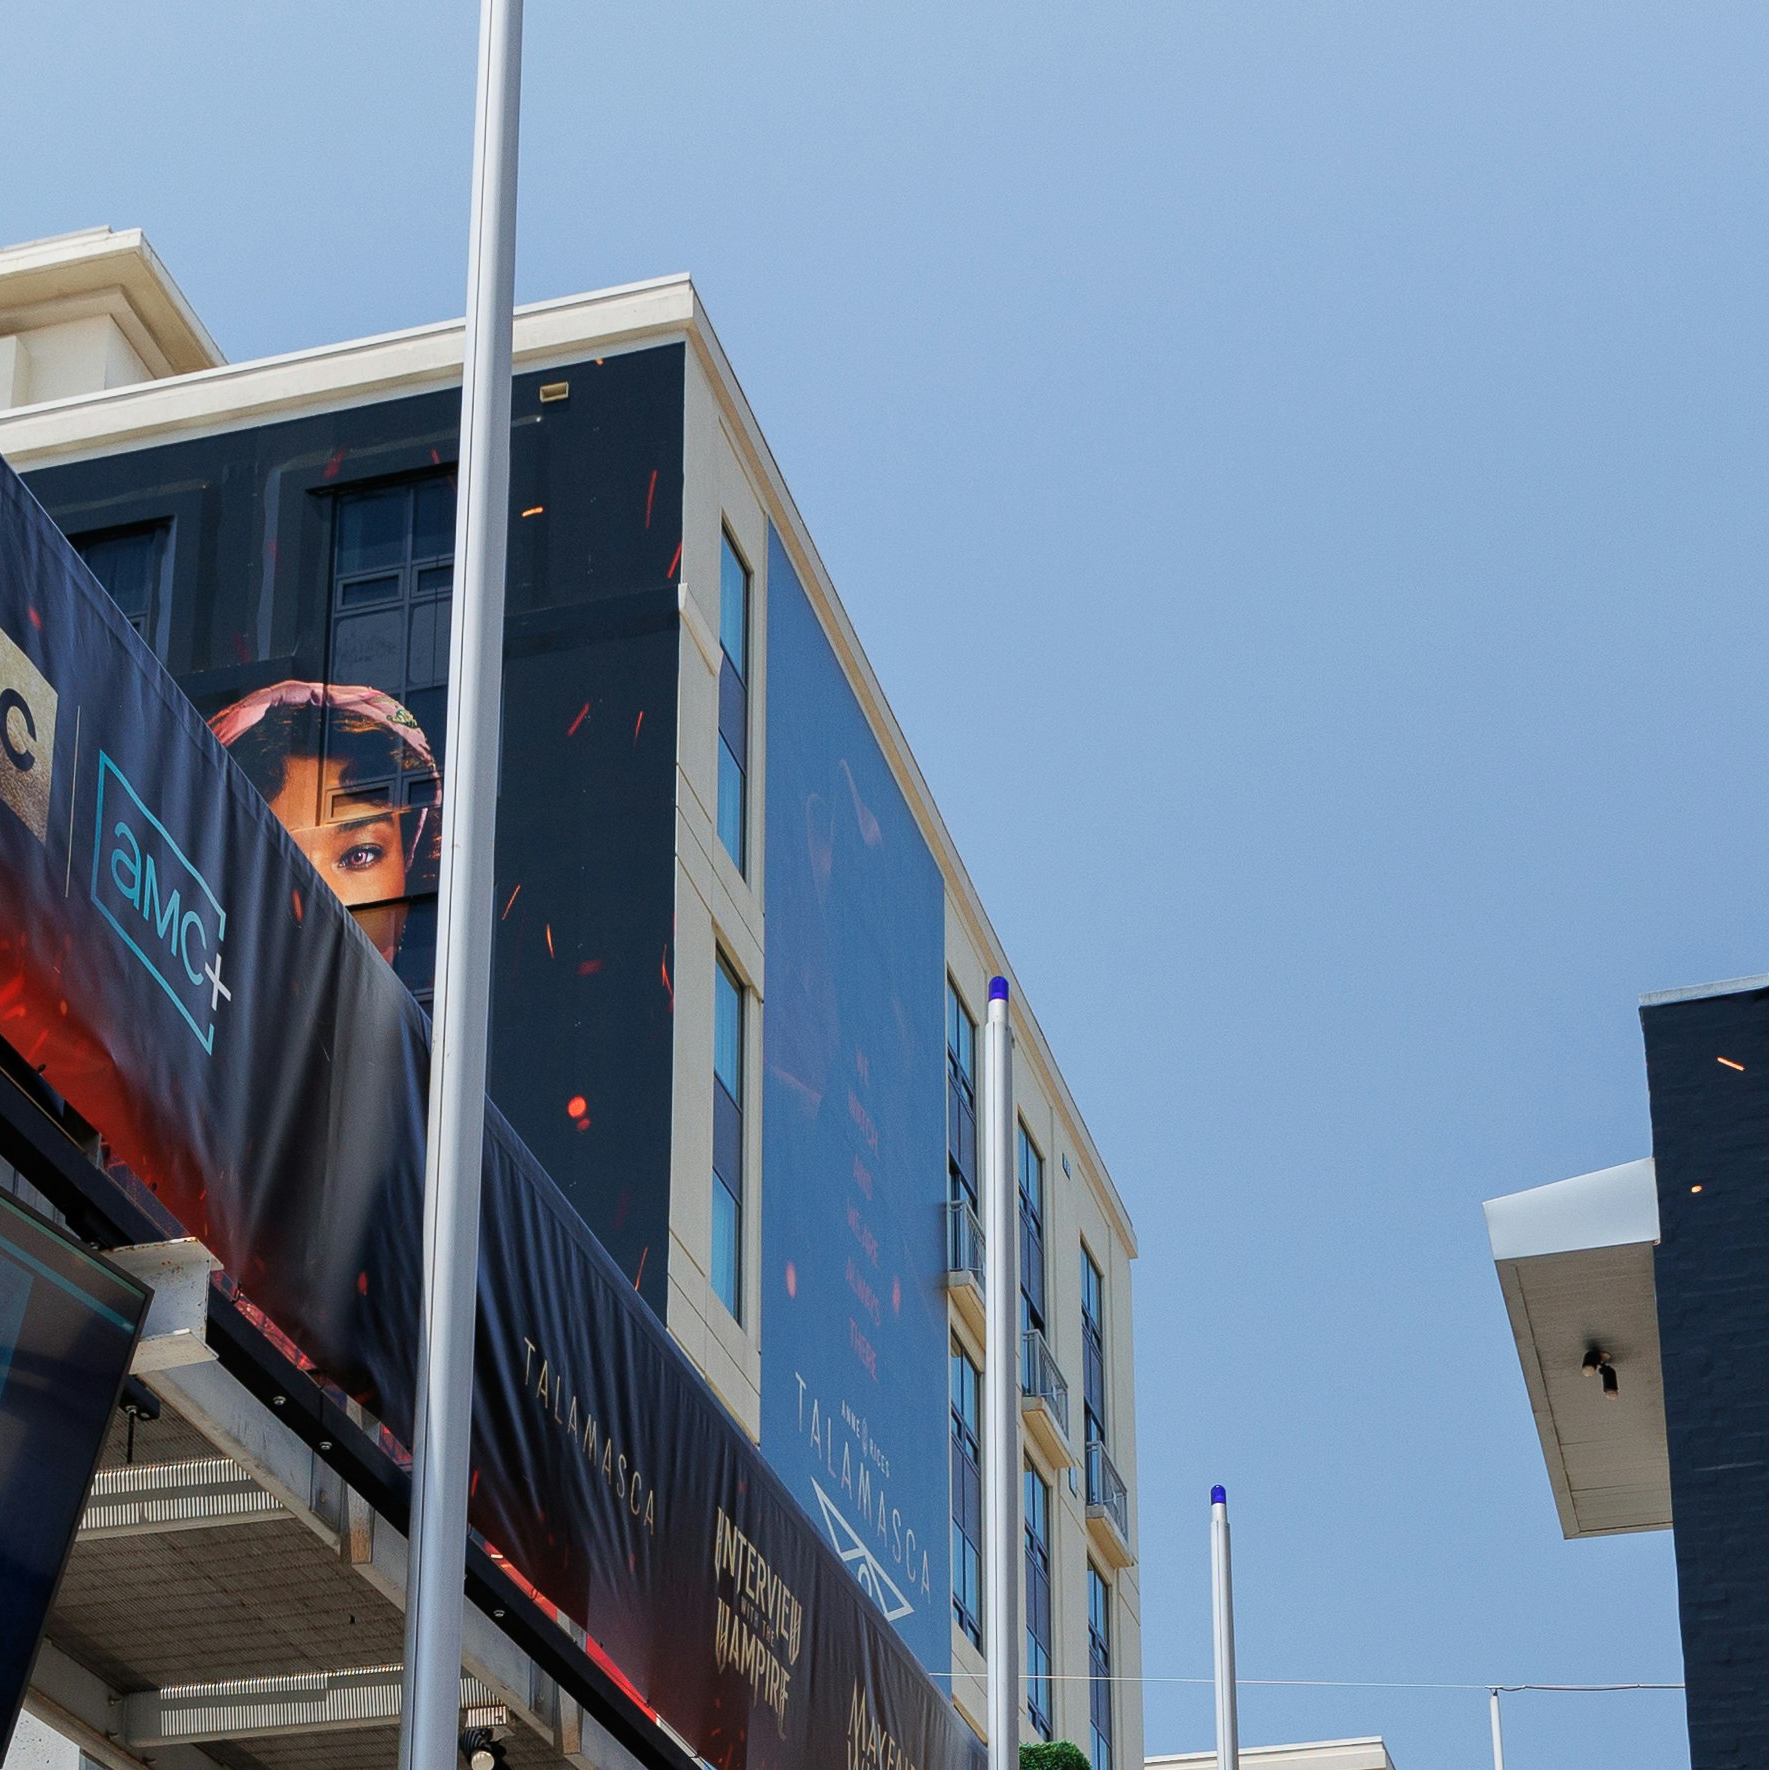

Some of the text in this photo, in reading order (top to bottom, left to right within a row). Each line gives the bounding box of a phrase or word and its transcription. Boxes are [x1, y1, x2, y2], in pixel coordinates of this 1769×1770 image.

[524, 1336, 655, 1536] TALAMASCA
[795, 1371, 931, 1603] TALAMASCA
[714, 1505, 803, 1666] INTERVIEW
[740, 1595, 775, 1648] WITH THE
[714, 1596, 791, 1742] VAMPIRE
